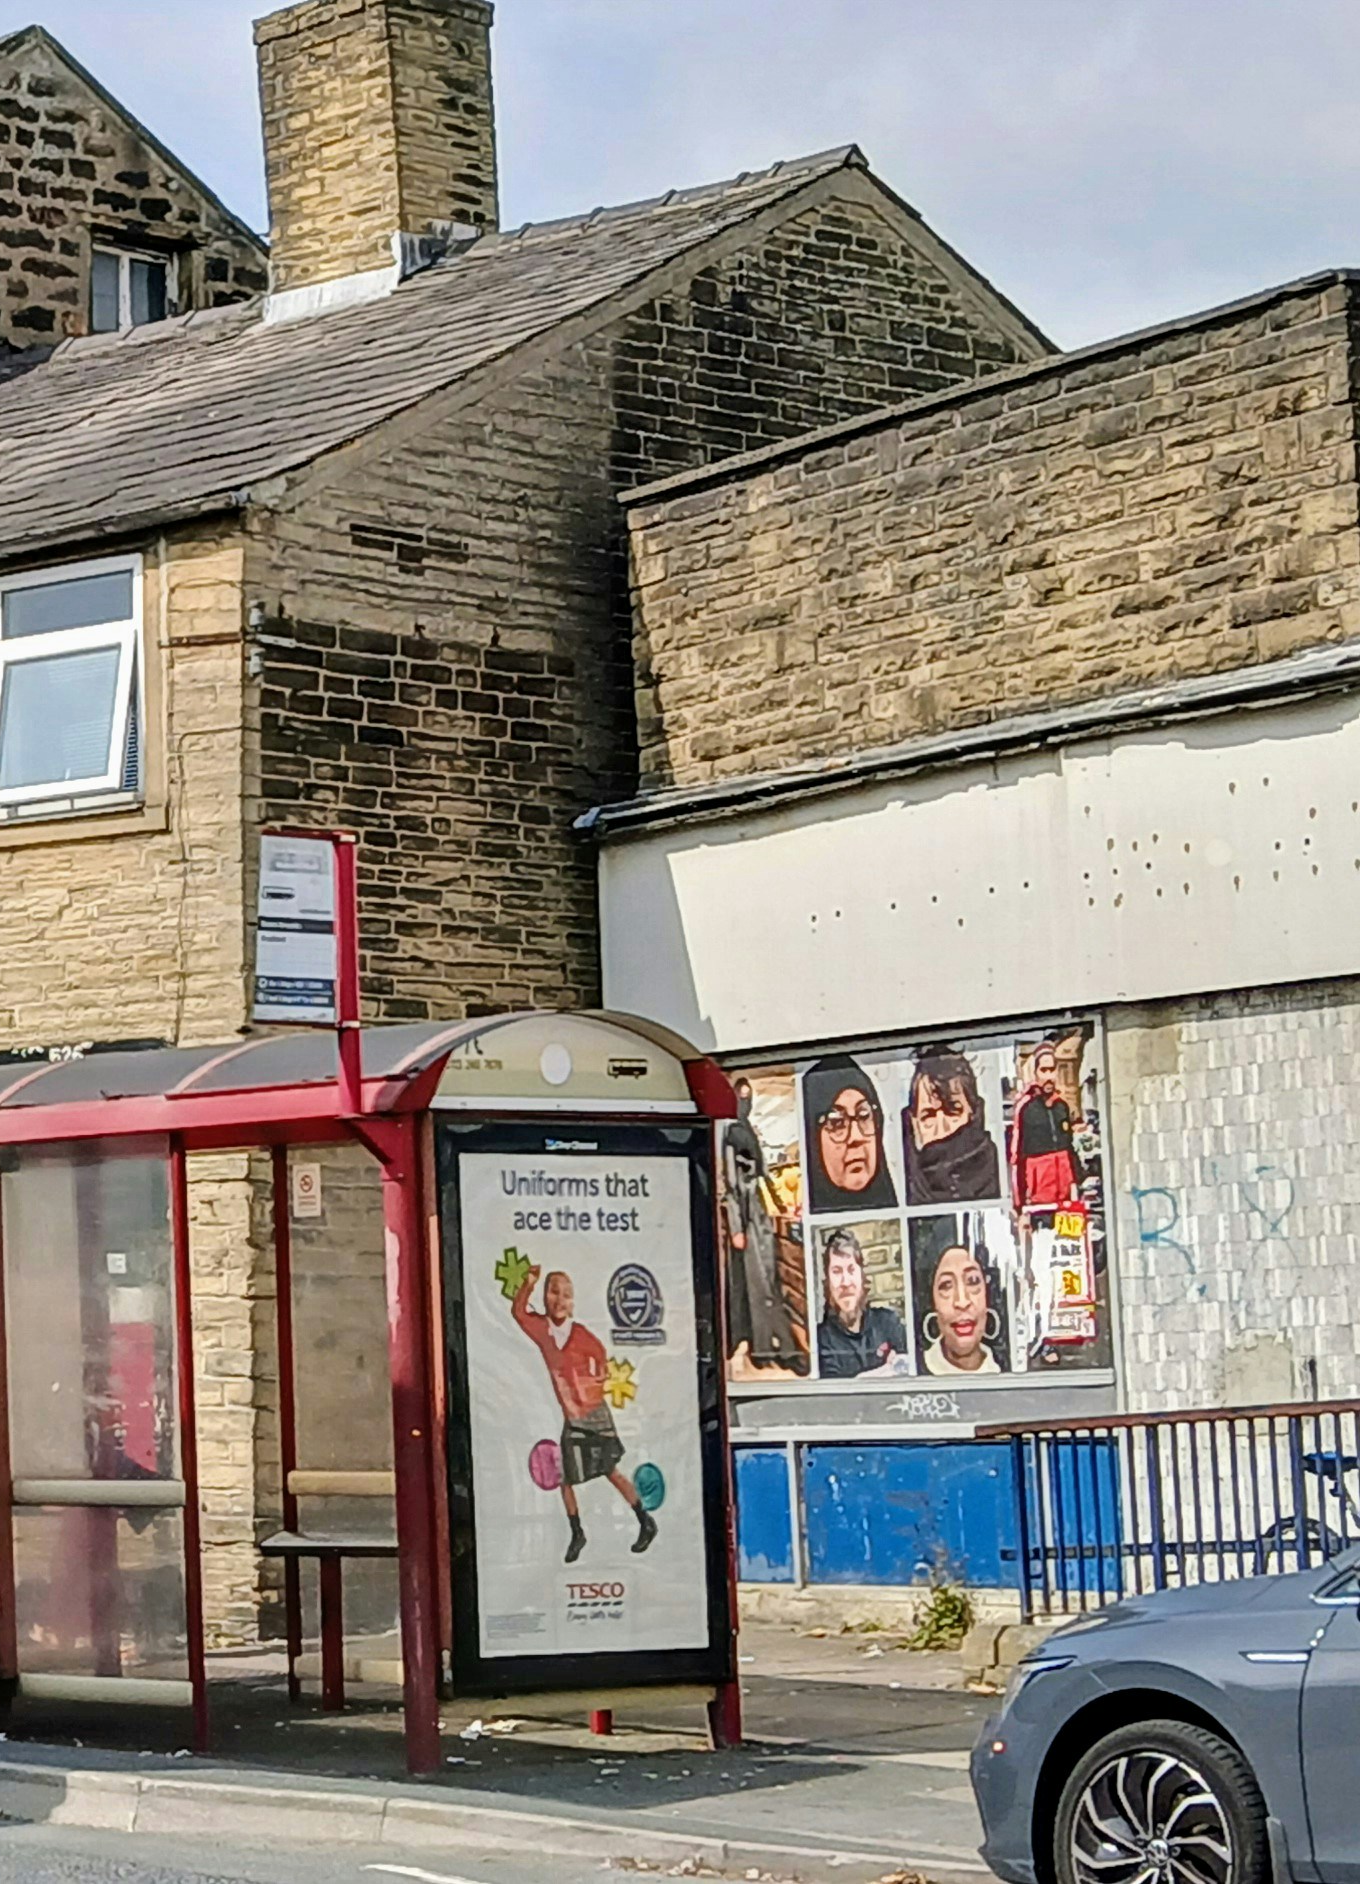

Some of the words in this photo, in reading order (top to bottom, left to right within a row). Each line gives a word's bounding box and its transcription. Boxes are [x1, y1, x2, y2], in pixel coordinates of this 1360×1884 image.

[501, 1170, 599, 1198] Uniforms
[605, 1172, 650, 1198] that
[513, 1210, 552, 1231] ace
[556, 1205, 591, 1232] the
[596, 1207, 640, 1232] test
[565, 1582, 625, 1599] TESCO
